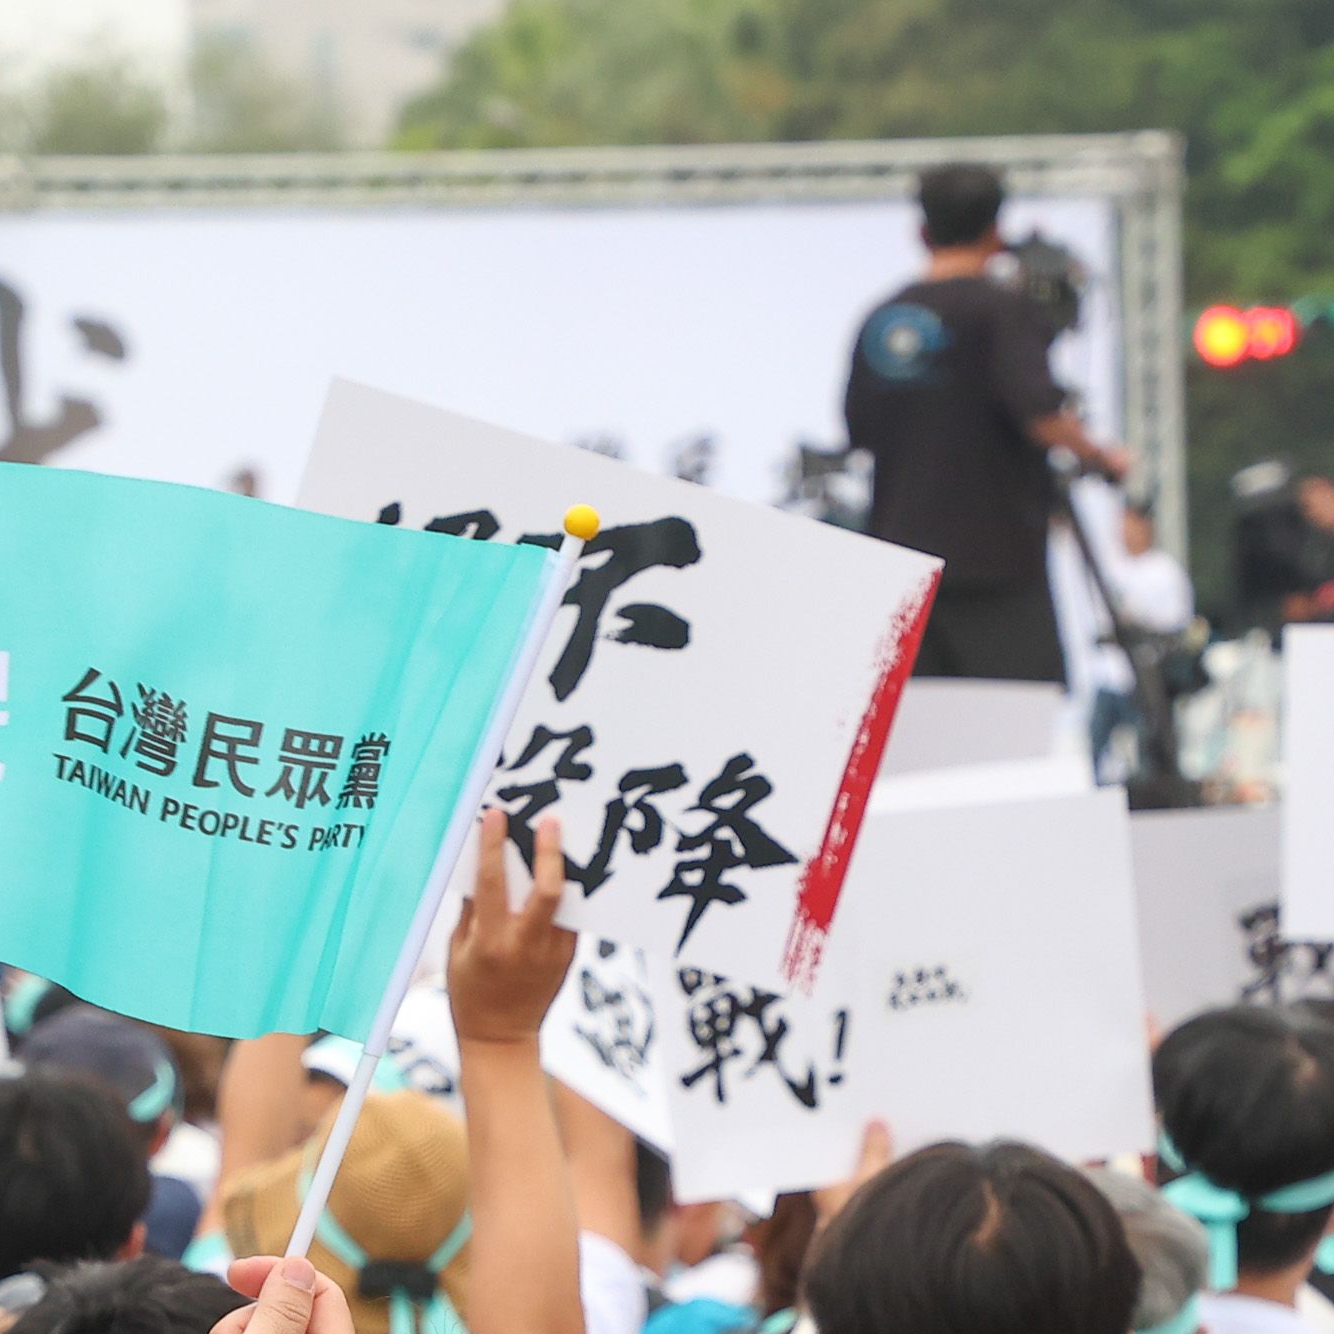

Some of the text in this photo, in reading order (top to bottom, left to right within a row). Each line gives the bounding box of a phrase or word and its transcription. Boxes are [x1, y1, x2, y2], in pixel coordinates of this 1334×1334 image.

[60, 666, 391, 810] 台灣民眾黨
[52, 752, 152, 816] TAIWAN
[159, 796, 300, 850] PEOPLE'S
